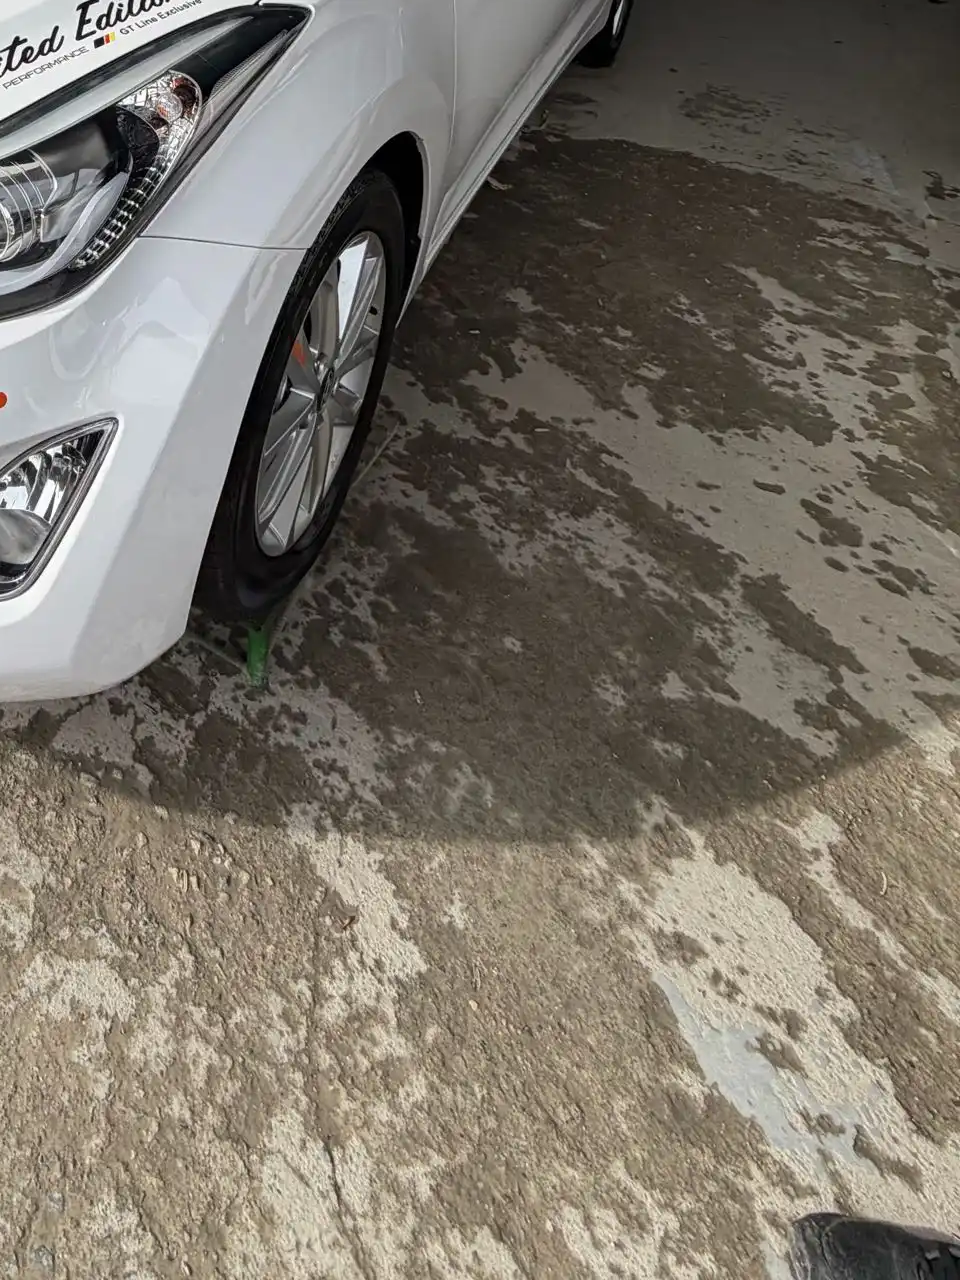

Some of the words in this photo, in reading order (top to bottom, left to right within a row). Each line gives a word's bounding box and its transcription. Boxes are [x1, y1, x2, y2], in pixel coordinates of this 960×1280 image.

[120, 23, 135, 36] GT
[136, 15, 157, 30] Line
[2, 46, 89, 90] PERFORMANCE
